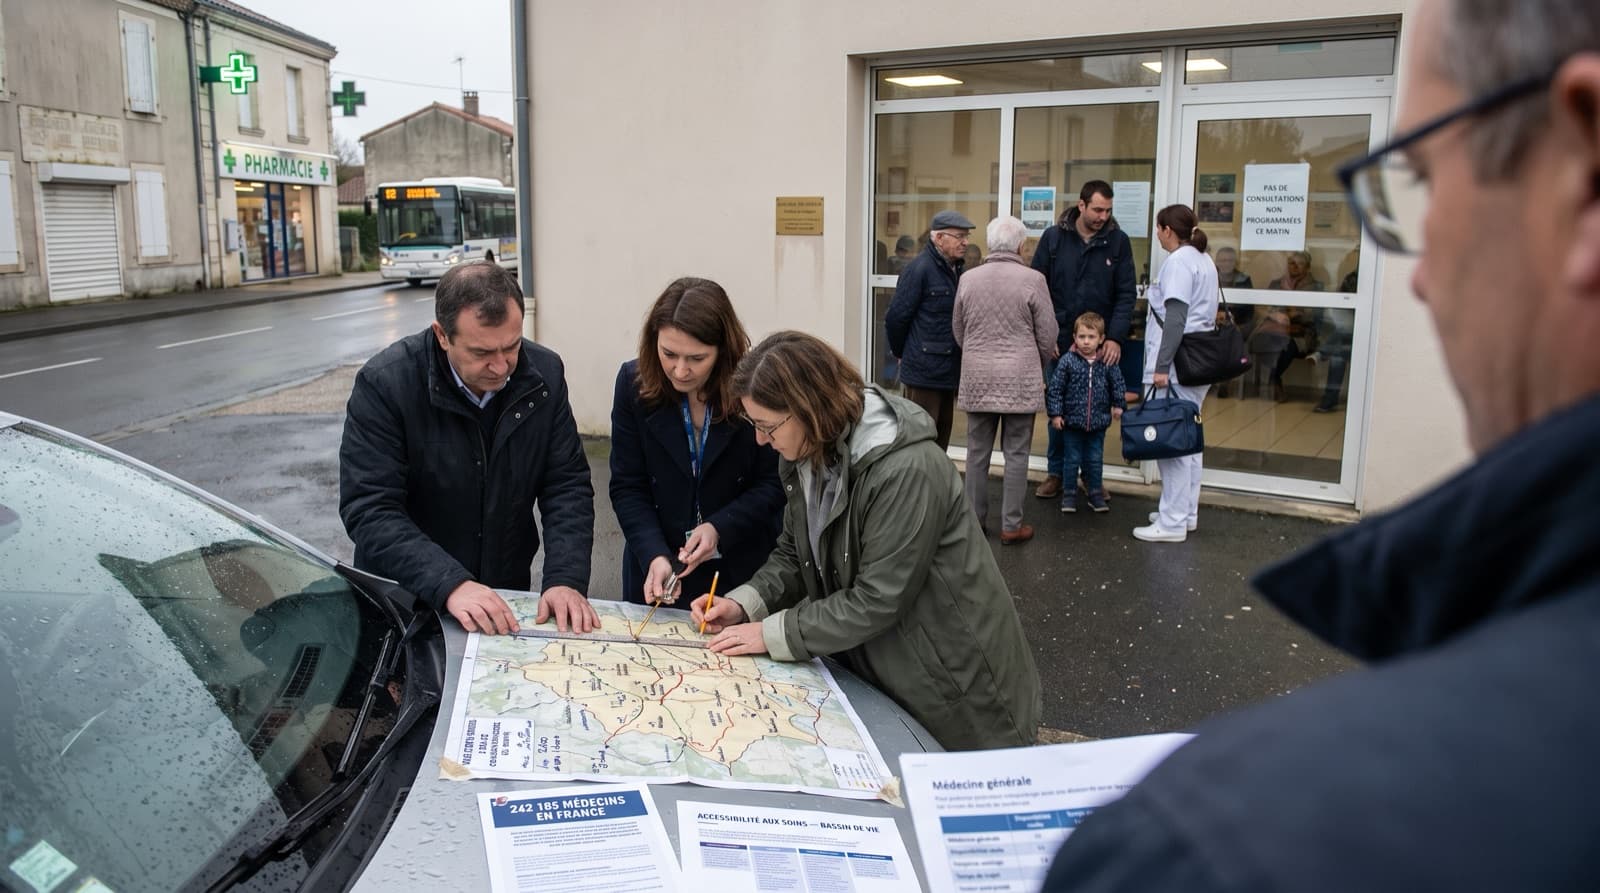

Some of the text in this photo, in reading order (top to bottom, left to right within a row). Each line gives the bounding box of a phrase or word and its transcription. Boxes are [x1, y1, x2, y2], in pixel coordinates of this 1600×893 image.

[244, 153, 313, 179] PHARMACIE
[1246, 216, 1302, 224] PROGRAMMÉES
[932, 776, 1032, 790] Médecine générale
[509, 795, 626, 814] 242 185 MÉDECINS
[536, 807, 606, 821] EN FRANCE
[697, 812, 760, 824] ACCESSIBILITÉ
[762, 817, 780, 826] AUX
[781, 818, 808, 827] SOINS
[820, 821, 852, 831] BASSIN
[853, 824, 865, 832] DE
[865, 825, 880, 833] VIE
